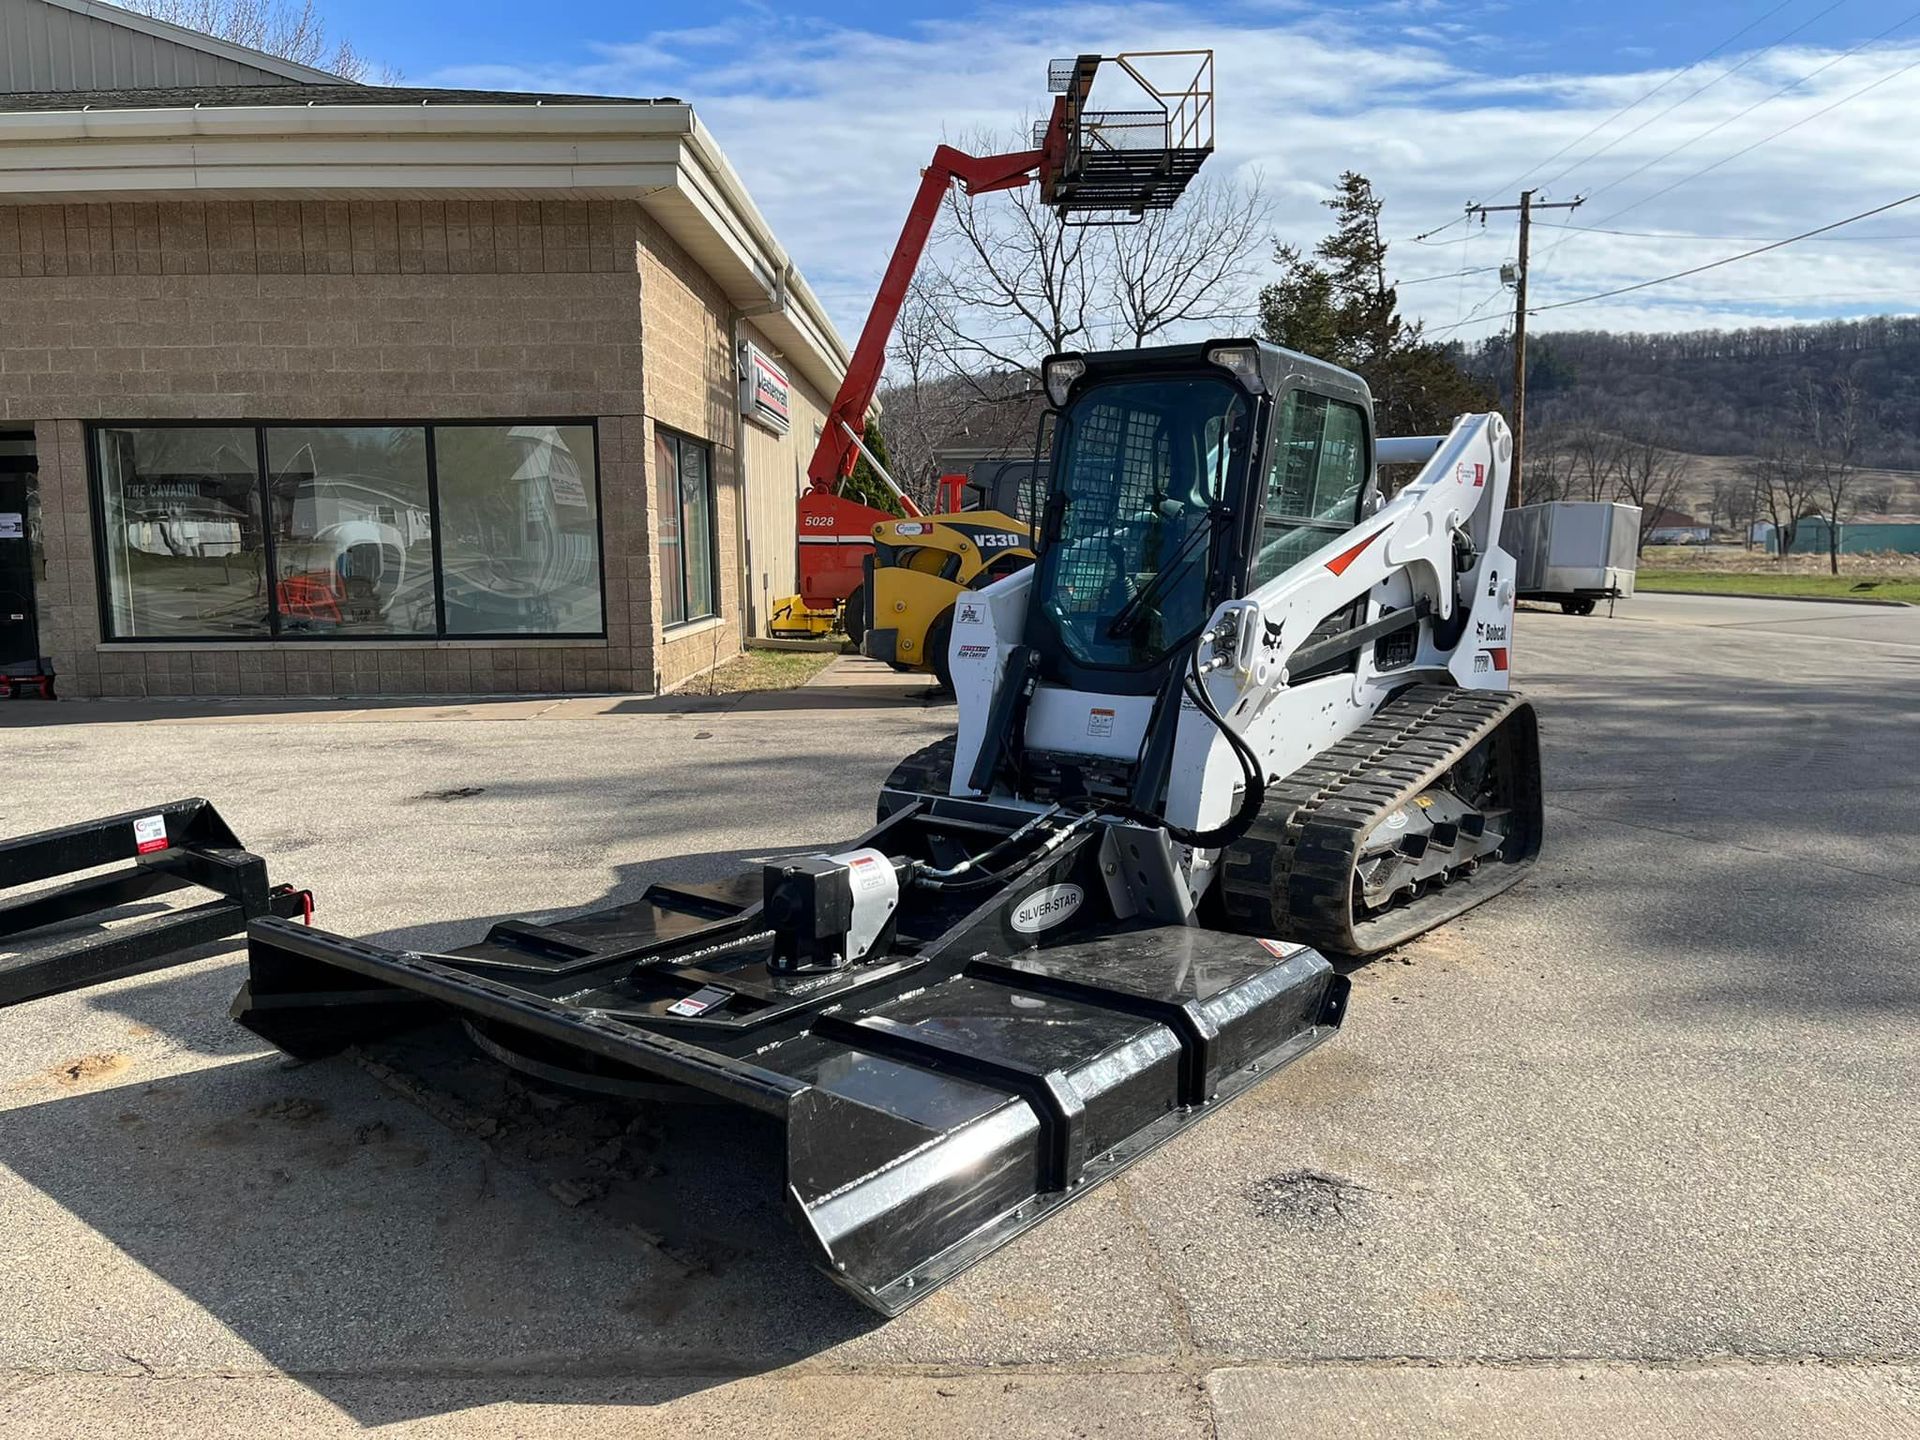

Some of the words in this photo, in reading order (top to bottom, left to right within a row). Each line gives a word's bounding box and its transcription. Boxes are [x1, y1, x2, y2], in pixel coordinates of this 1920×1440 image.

[126, 484, 145, 497] THE
[149, 483, 200, 497] CAVADINI
[804, 516, 834, 526] 5028
[973, 534, 1019, 547] V330
[1485, 623, 1507, 641] Bobcat
[1019, 892, 1077, 923] SILVER-STAR
